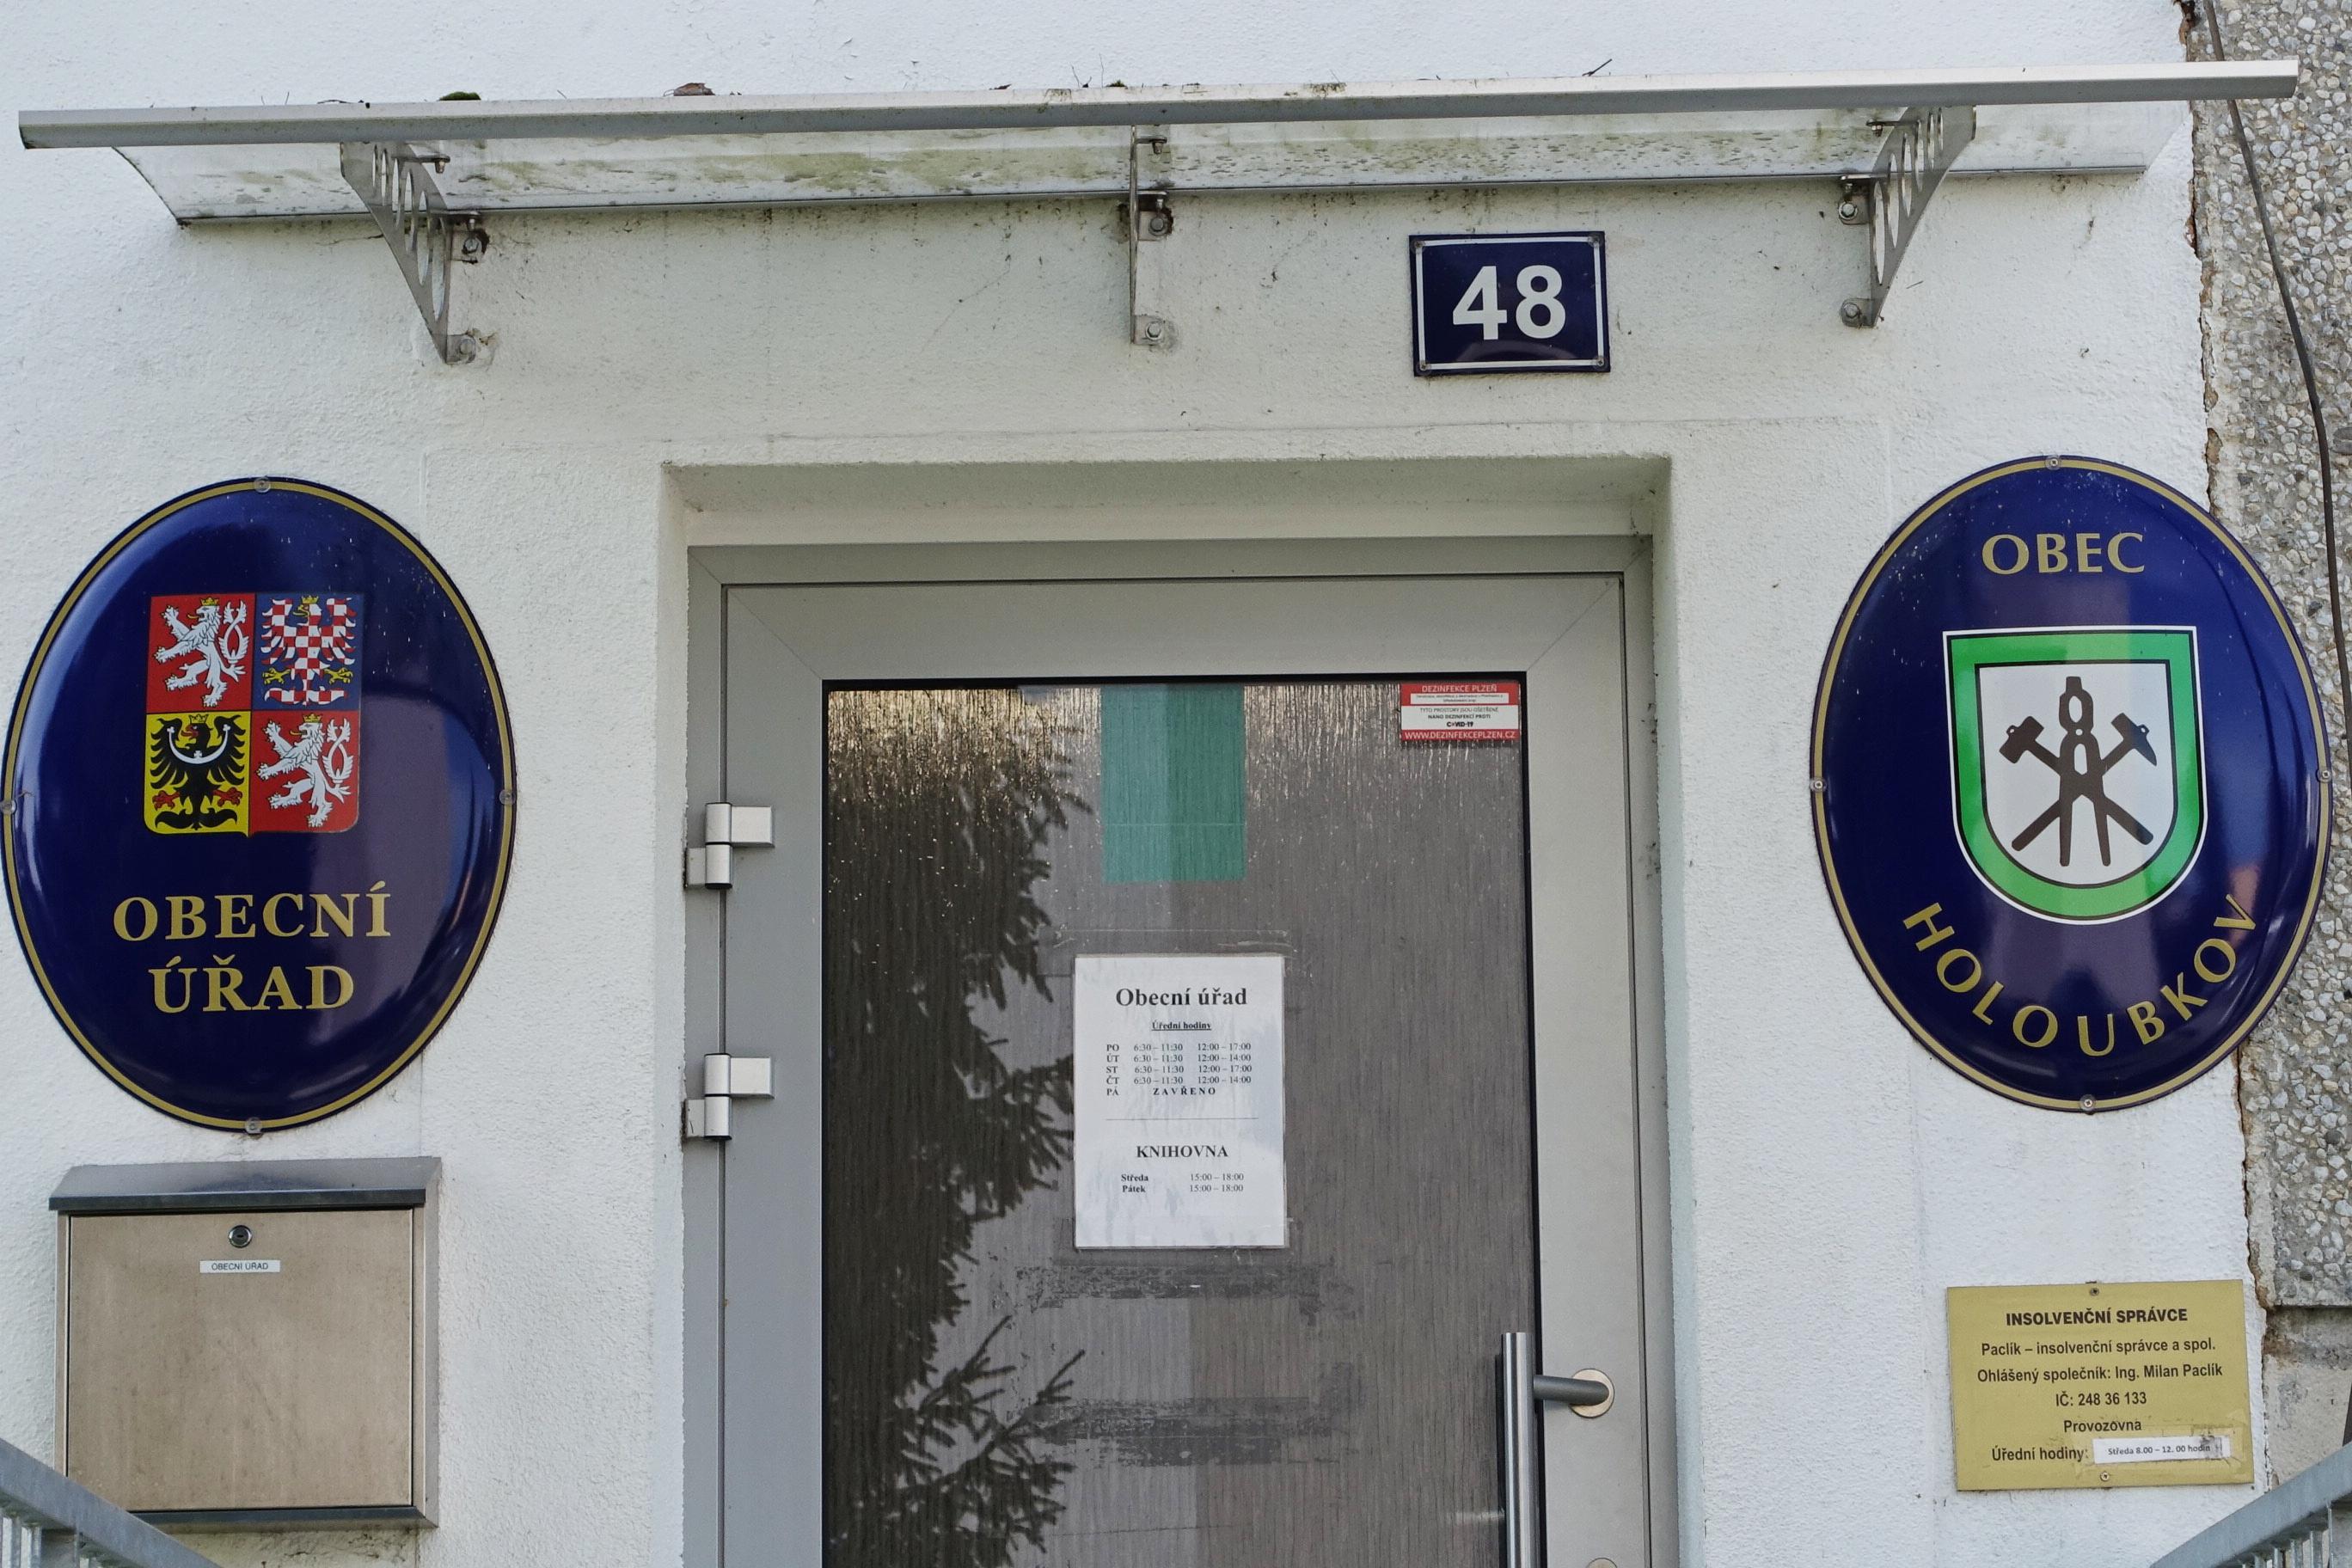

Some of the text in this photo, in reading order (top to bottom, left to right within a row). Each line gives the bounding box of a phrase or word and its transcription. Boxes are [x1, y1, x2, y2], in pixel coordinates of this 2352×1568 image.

[1453, 265, 1566, 340] 48
[1981, 532, 2147, 575] OBEC
[113, 880, 392, 942] OBECNÍ
[1902, 893, 2257, 1057] HOLOUBKOV
[148, 955, 354, 1014] ÚŘAD
[1116, 988, 1247, 1006] Obecní úřad
[1183, 1022, 1211, 1031] hodiny
[1136, 1145, 1228, 1157] KNIHOVNA
[1121, 1173, 1148, 1182] Středa
[1122, 1185, 1146, 1193] Pátek
[2006, 1307, 2188, 1326] INSOLVENČNÍ SPRÁVCE
[1981, 1342, 2021, 1356] Paclík
[2037, 1340, 2112, 1354] insolvenční
[2116, 1338, 2168, 1355] správce
[2172, 1341, 2179, 1351] a
[2184, 1338, 2215, 1353] spol.
[1977, 1363, 2223, 1384] Ohlášený společník: Ing. Milan Paclík
[2055, 1391, 2147, 1406] IČ: 248 36 133
[2063, 1419, 2142, 1433] Provozovna
[1992, 1445, 2089, 1462] Úřední hodiny:
